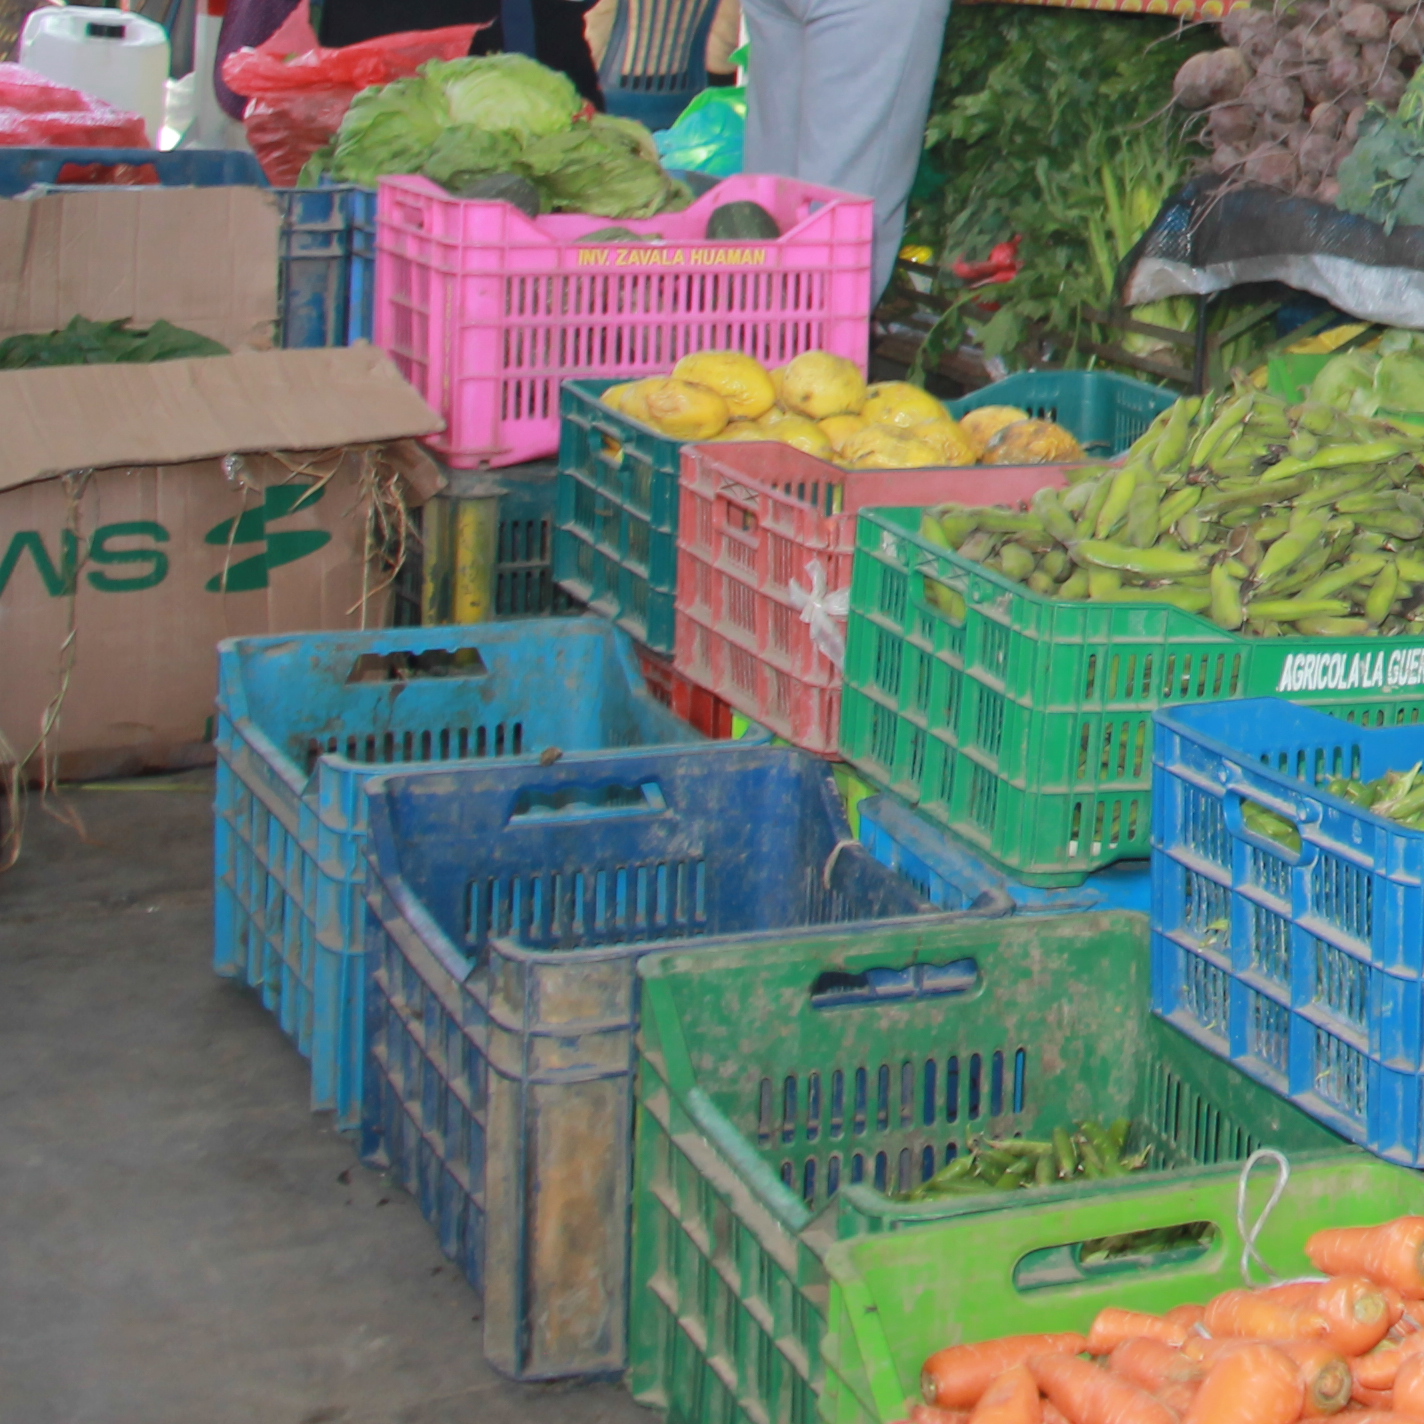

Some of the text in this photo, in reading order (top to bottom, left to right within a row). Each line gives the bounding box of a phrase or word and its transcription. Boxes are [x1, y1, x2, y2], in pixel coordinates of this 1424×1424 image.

[616, 248, 686, 266] ZAVALA
[690, 247, 767, 266] HUAMAN
[1279, 652, 1359, 693] AGRICOLA
[1362, 650, 1385, 688] LA
